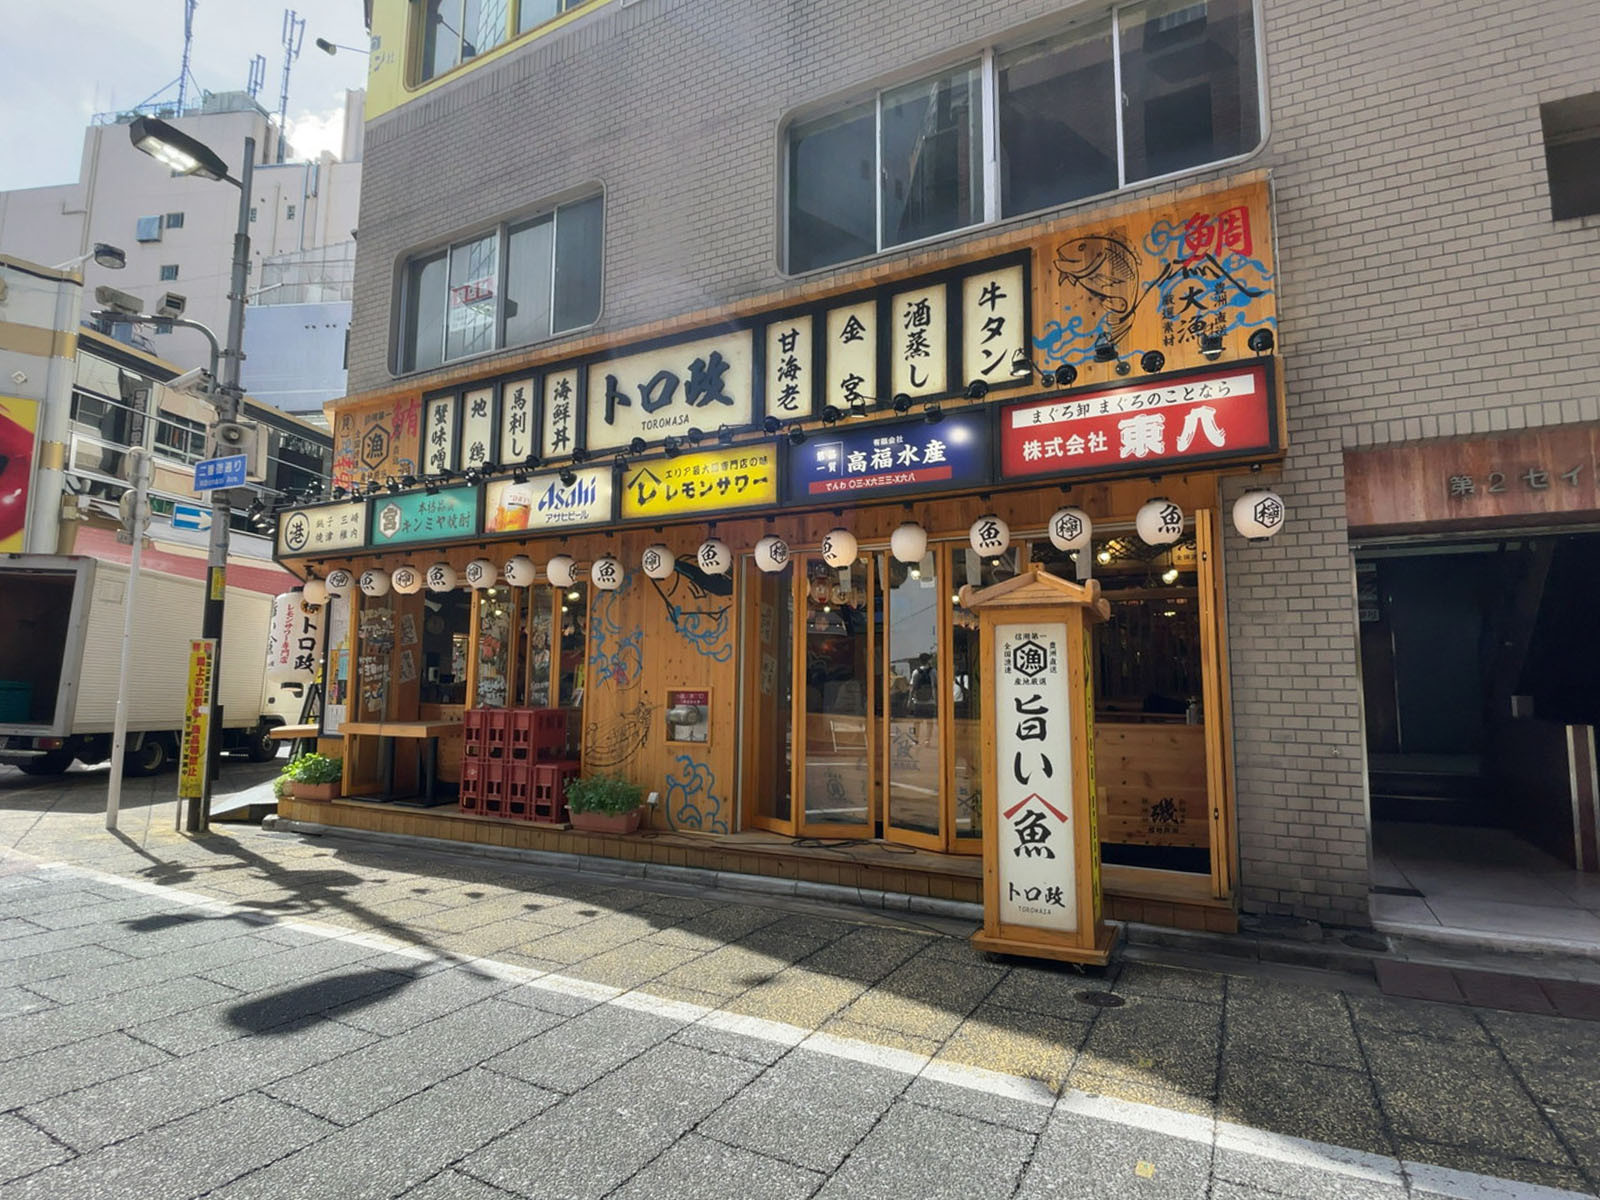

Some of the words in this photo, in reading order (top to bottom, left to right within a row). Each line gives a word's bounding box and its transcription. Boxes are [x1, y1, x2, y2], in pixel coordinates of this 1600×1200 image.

[1183, 205, 1253, 266] 鯛
[904, 297, 931, 388] 酒蒸し
[978, 281, 1008, 376] 牛タン
[777, 328, 802, 411] 甘海老
[839, 314, 866, 403] 金宮
[604, 350, 735, 425] トロ政
[1032, 402, 1090, 424] まぐろ卸
[1099, 380, 1232, 414] まぐろのことなら
[469, 398, 488, 463] 地鶏
[509, 387, 527, 457] 馬刺し
[551, 378, 572, 453] 海鮮丼
[641, 414, 690, 431] TOROMASA
[1022, 431, 1108, 461] 株式会社
[1118, 405, 1226, 459] 東八
[366, 433, 384, 459] 漁
[430, 403, 448, 474] 蟹味噌
[847, 439, 947, 473] 高福水産
[538, 476, 596, 511] Asahi
[666, 475, 768, 501] レモンサワー
[402, 512, 471, 533] キンミヤ焼酎
[545, 511, 589, 523] アサヒビール
[978, 520, 1002, 547] 魚
[1158, 503, 1182, 534] 魚
[597, 562, 616, 582] 魚
[702, 544, 720, 567] 魚
[294, 616, 318, 674] トロ政
[1019, 648, 1043, 670] 漁
[1013, 694, 1056, 860] 旨い魚
[1007, 881, 1066, 909] トロ政
